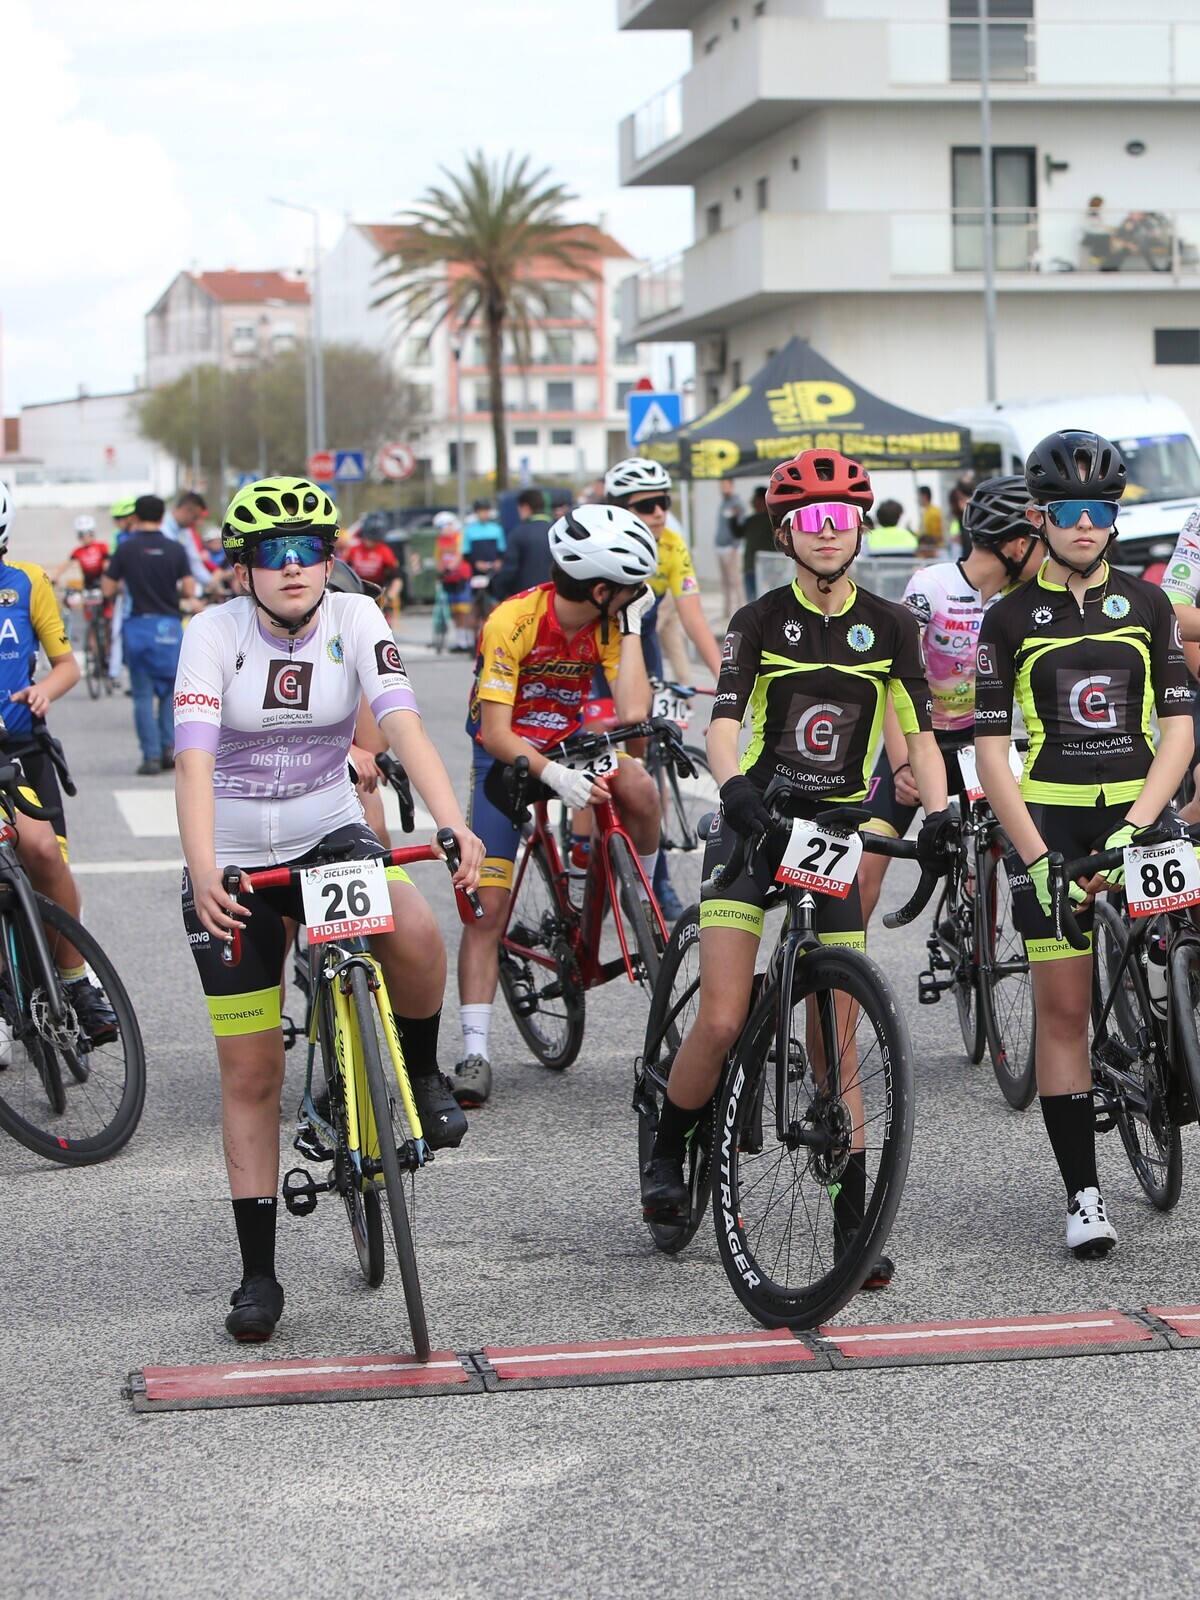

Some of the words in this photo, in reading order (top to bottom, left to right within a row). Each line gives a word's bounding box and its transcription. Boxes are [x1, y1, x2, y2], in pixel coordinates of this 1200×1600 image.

[952, 635, 971, 650] CA
[262, 715, 276, 724] CEG
[278, 712, 314, 722] GONÇALVES
[1085, 735, 1133, 751] GONÇALVES
[250, 752, 312, 768] DISTRITO
[775, 763, 793, 778] CEG
[796, 771, 846, 785] GONÇALVES
[816, 826, 850, 842] CICLISMO
[797, 837, 850, 877] 27
[1142, 847, 1176, 861] CICLISMO
[323, 867, 362, 880] CICLISMO
[781, 867, 847, 893] FIDELIDADE
[1139, 858, 1186, 899] 86
[321, 879, 371, 922] 26
[712, 909, 761, 926] AZEITONENSE
[312, 916, 388, 938] FIDELIDADE
[212, 1007, 264, 1021] AZEITONENSE
[719, 1062, 761, 1291] BONTRAGER
